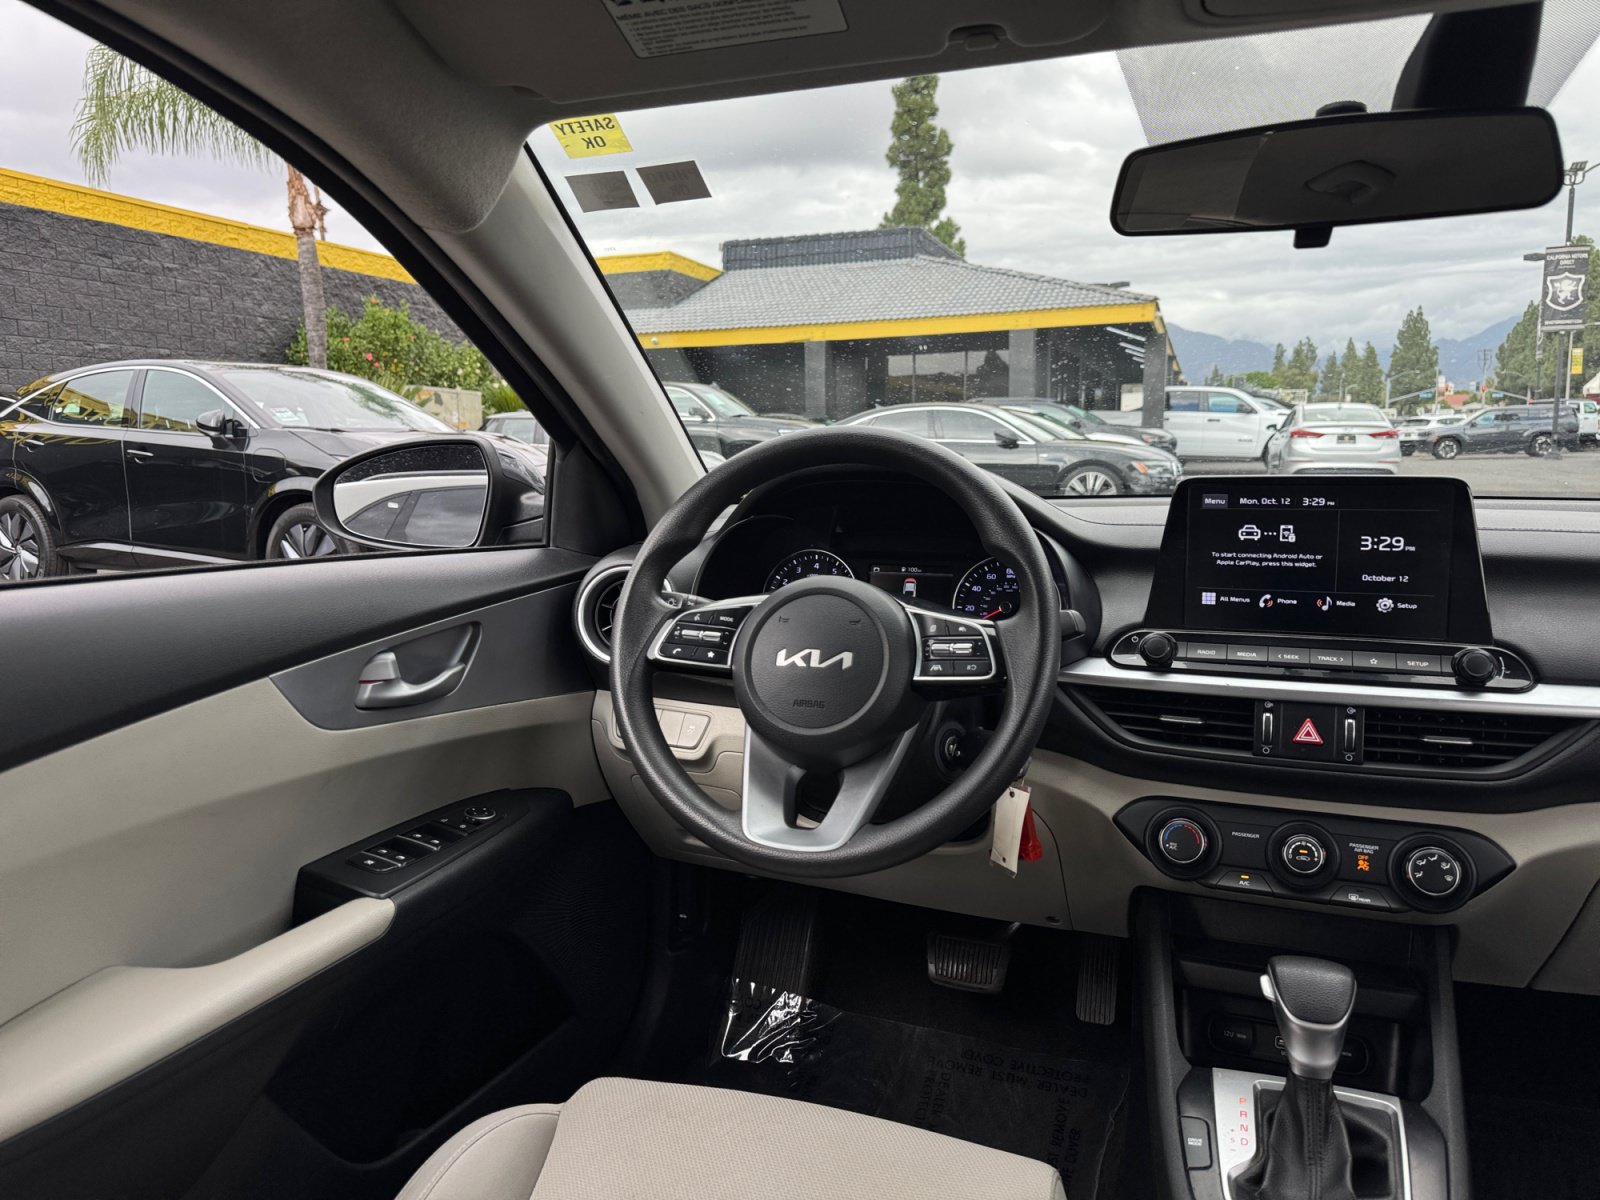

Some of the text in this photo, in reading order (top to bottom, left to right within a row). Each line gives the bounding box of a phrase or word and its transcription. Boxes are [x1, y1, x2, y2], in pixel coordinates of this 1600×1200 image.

[1302, 498, 1326, 506] 3:29
[1360, 536, 1404, 551] 3:29
[792, 700, 825, 709] AIRBAG
[928, 1055, 1088, 1098] DEALER MUST REMOVE
[1052, 1098, 1070, 1148] REMOVE
